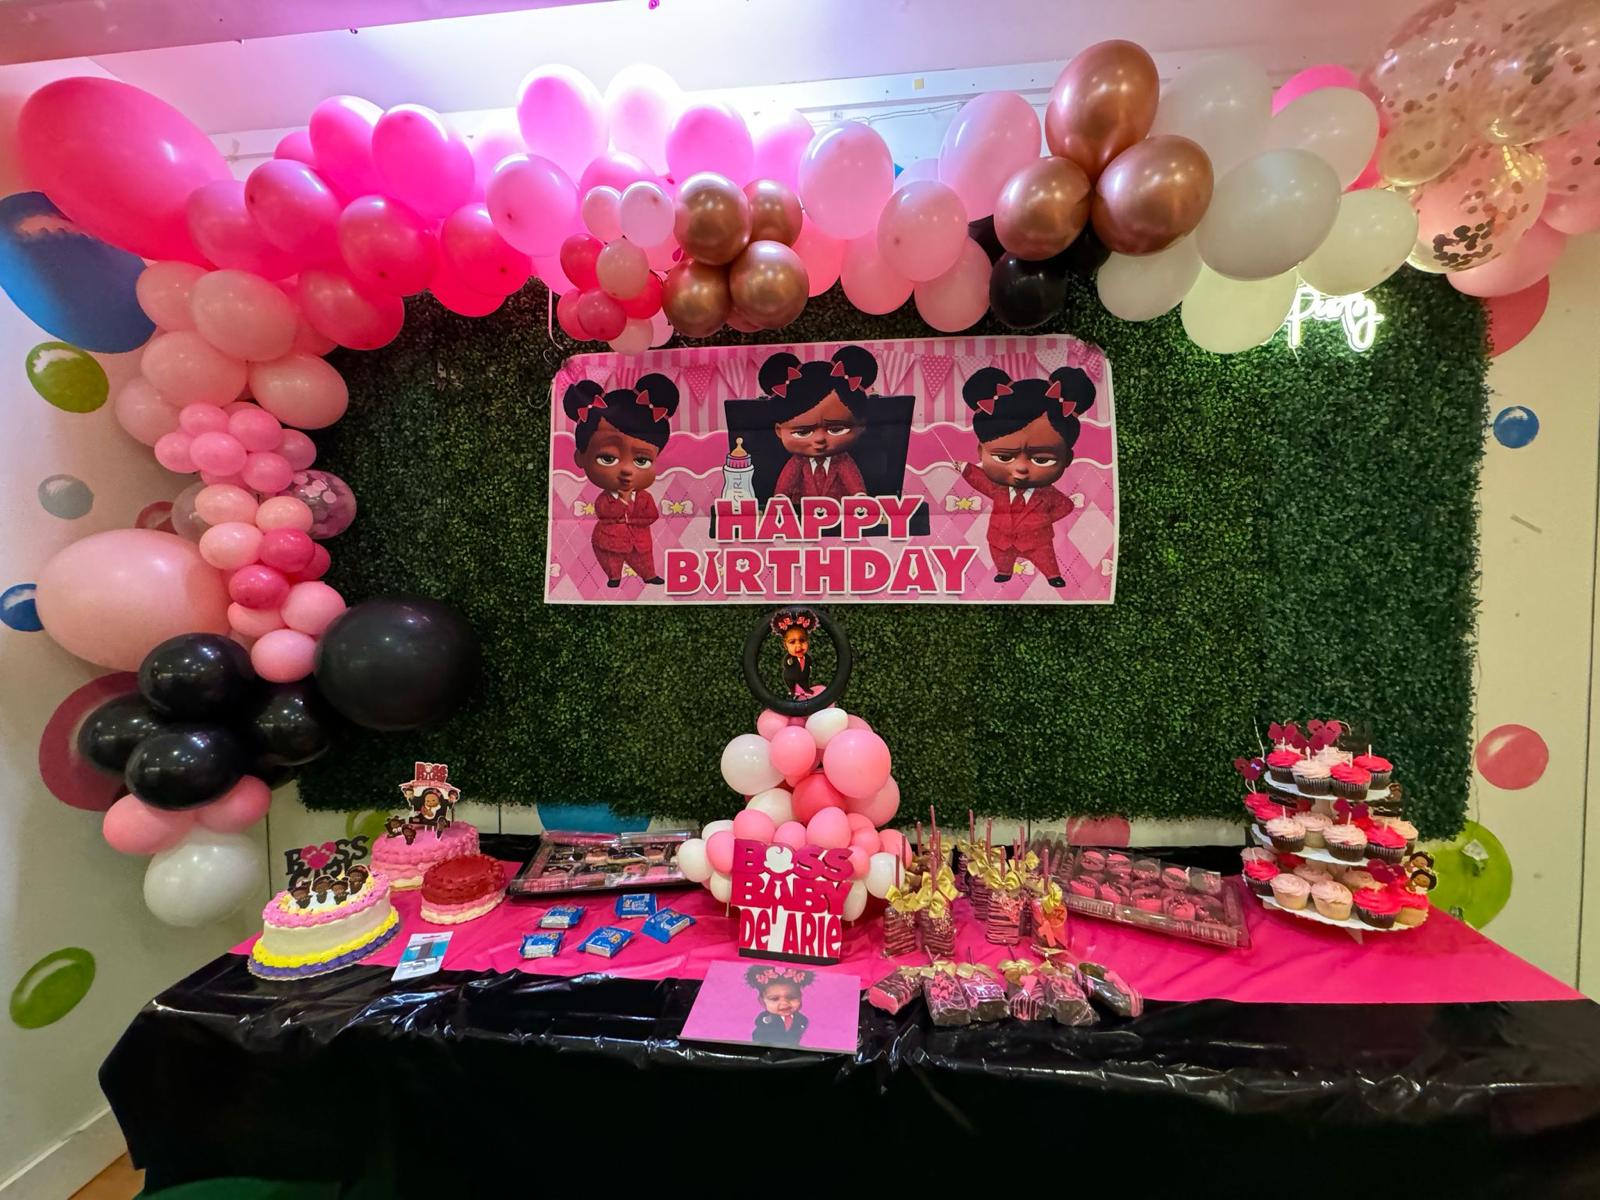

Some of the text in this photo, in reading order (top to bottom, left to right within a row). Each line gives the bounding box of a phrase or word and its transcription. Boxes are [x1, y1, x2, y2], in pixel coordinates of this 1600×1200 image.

[715, 495, 923, 542] HAPPY
[664, 547, 978, 595] BIRTHDAY
[733, 839, 855, 881] BOSS
[730, 873, 854, 915] BABY
